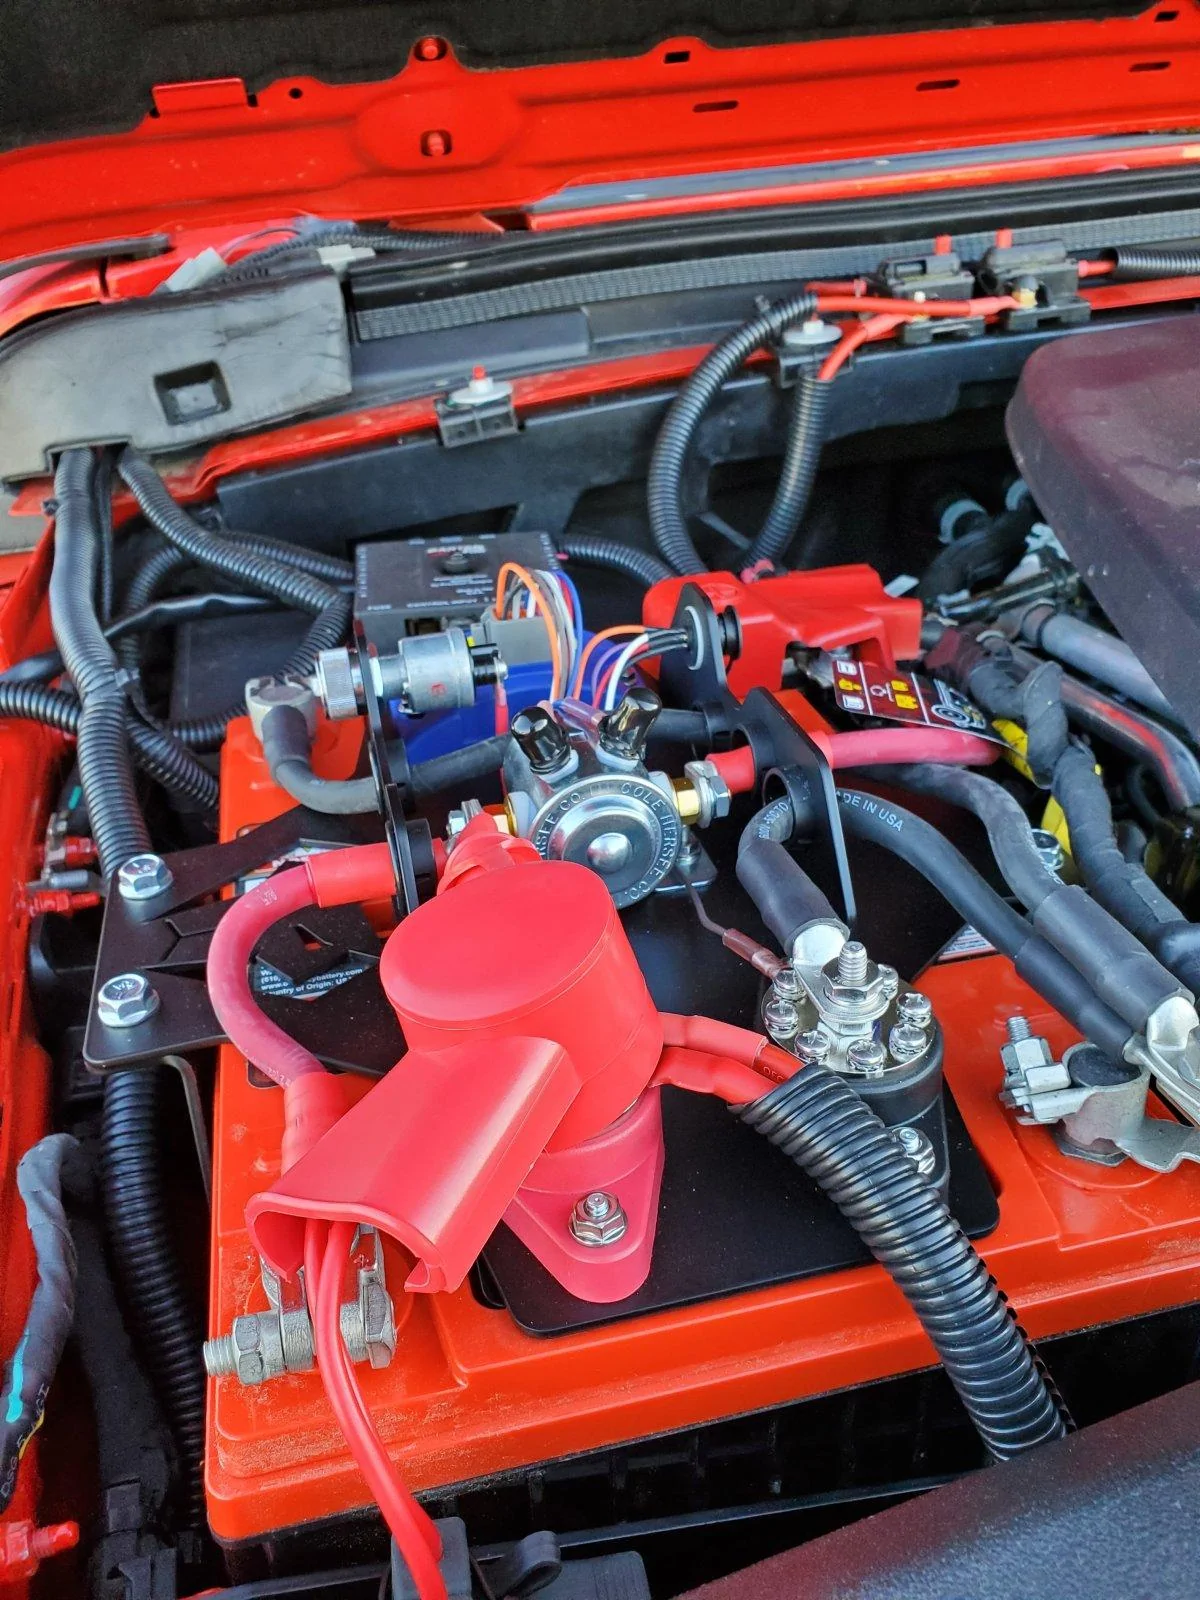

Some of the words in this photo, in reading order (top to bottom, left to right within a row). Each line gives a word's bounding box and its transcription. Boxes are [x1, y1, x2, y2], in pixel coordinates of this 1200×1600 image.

[621, 782, 666, 812] COLE
[651, 815, 678, 879] HERSEE
[862, 800, 878, 814] IN
[878, 808, 905, 832] USA
[537, 814, 559, 856] RSEE
[295, 984, 305, 992] of
[306, 980, 334, 991] Origin:
